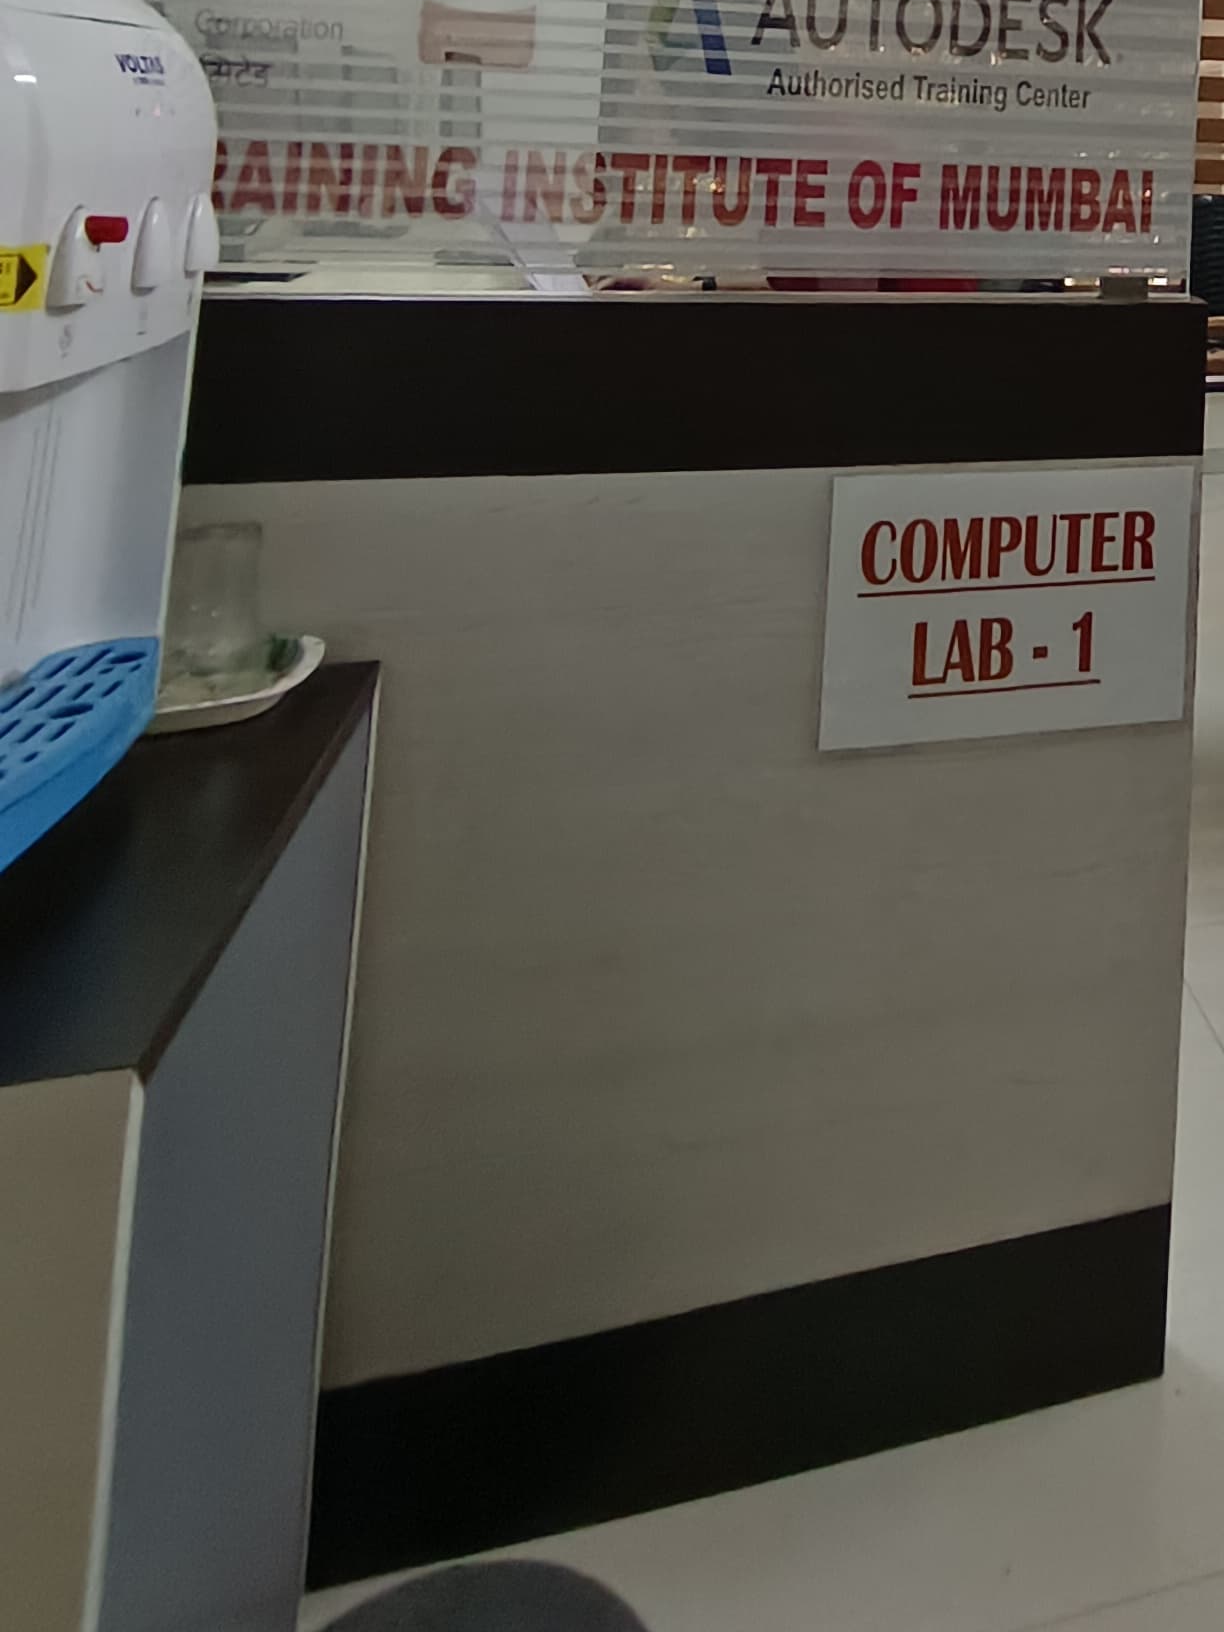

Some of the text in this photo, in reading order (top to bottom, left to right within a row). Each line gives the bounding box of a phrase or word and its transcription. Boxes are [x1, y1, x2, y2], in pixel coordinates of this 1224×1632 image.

[195, 9, 344, 42] Corporation
[767, 69, 1091, 112] Authorised Training Center
[502, 150, 826, 226] INSTITUTE
[847, 159, 921, 230] OF
[938, 165, 1153, 234] MUMBAI
[861, 511, 1156, 585] COMPUTER
[911, 617, 1014, 686] LAB
[1072, 611, 1093, 673] 1
